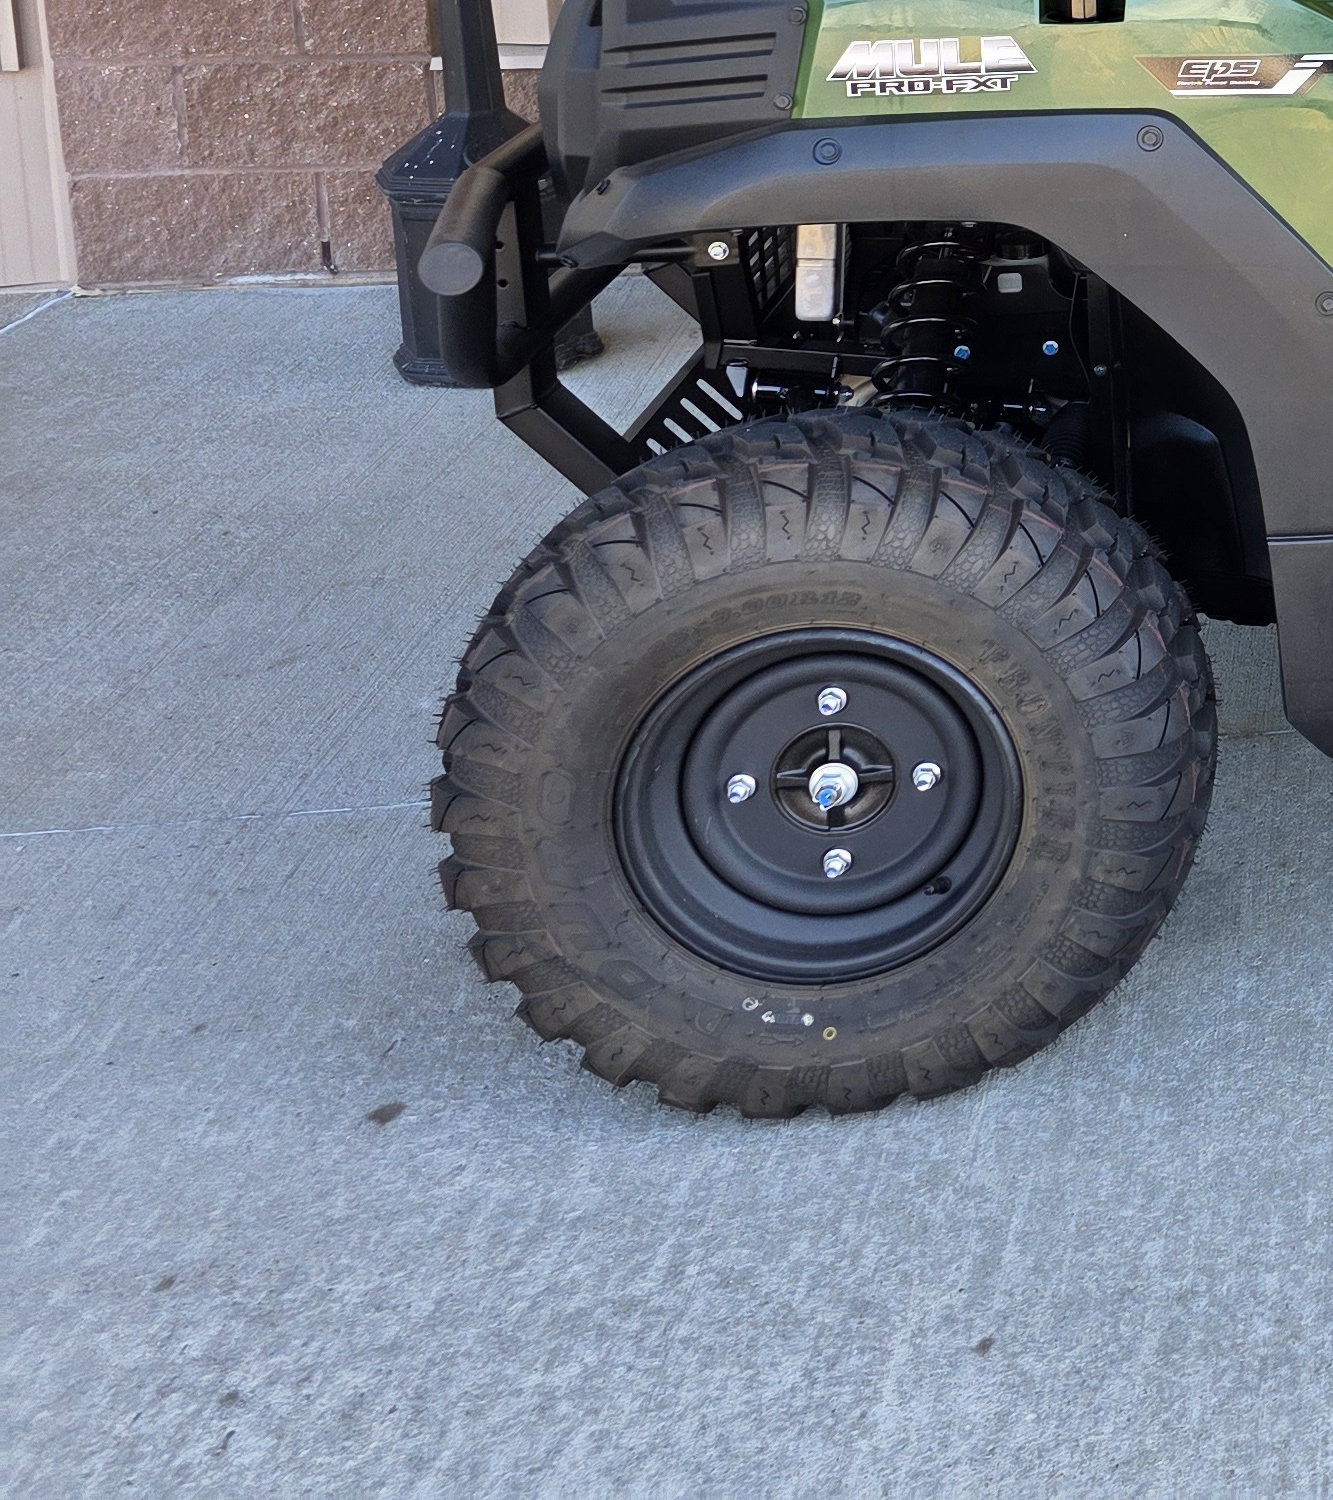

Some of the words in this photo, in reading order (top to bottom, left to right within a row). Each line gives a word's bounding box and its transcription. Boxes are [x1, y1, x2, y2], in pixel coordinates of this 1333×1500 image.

[826, 35, 1039, 82] MULE
[1177, 59, 1262, 82] EPS
[846, 74, 1019, 97] PRO-FXT
